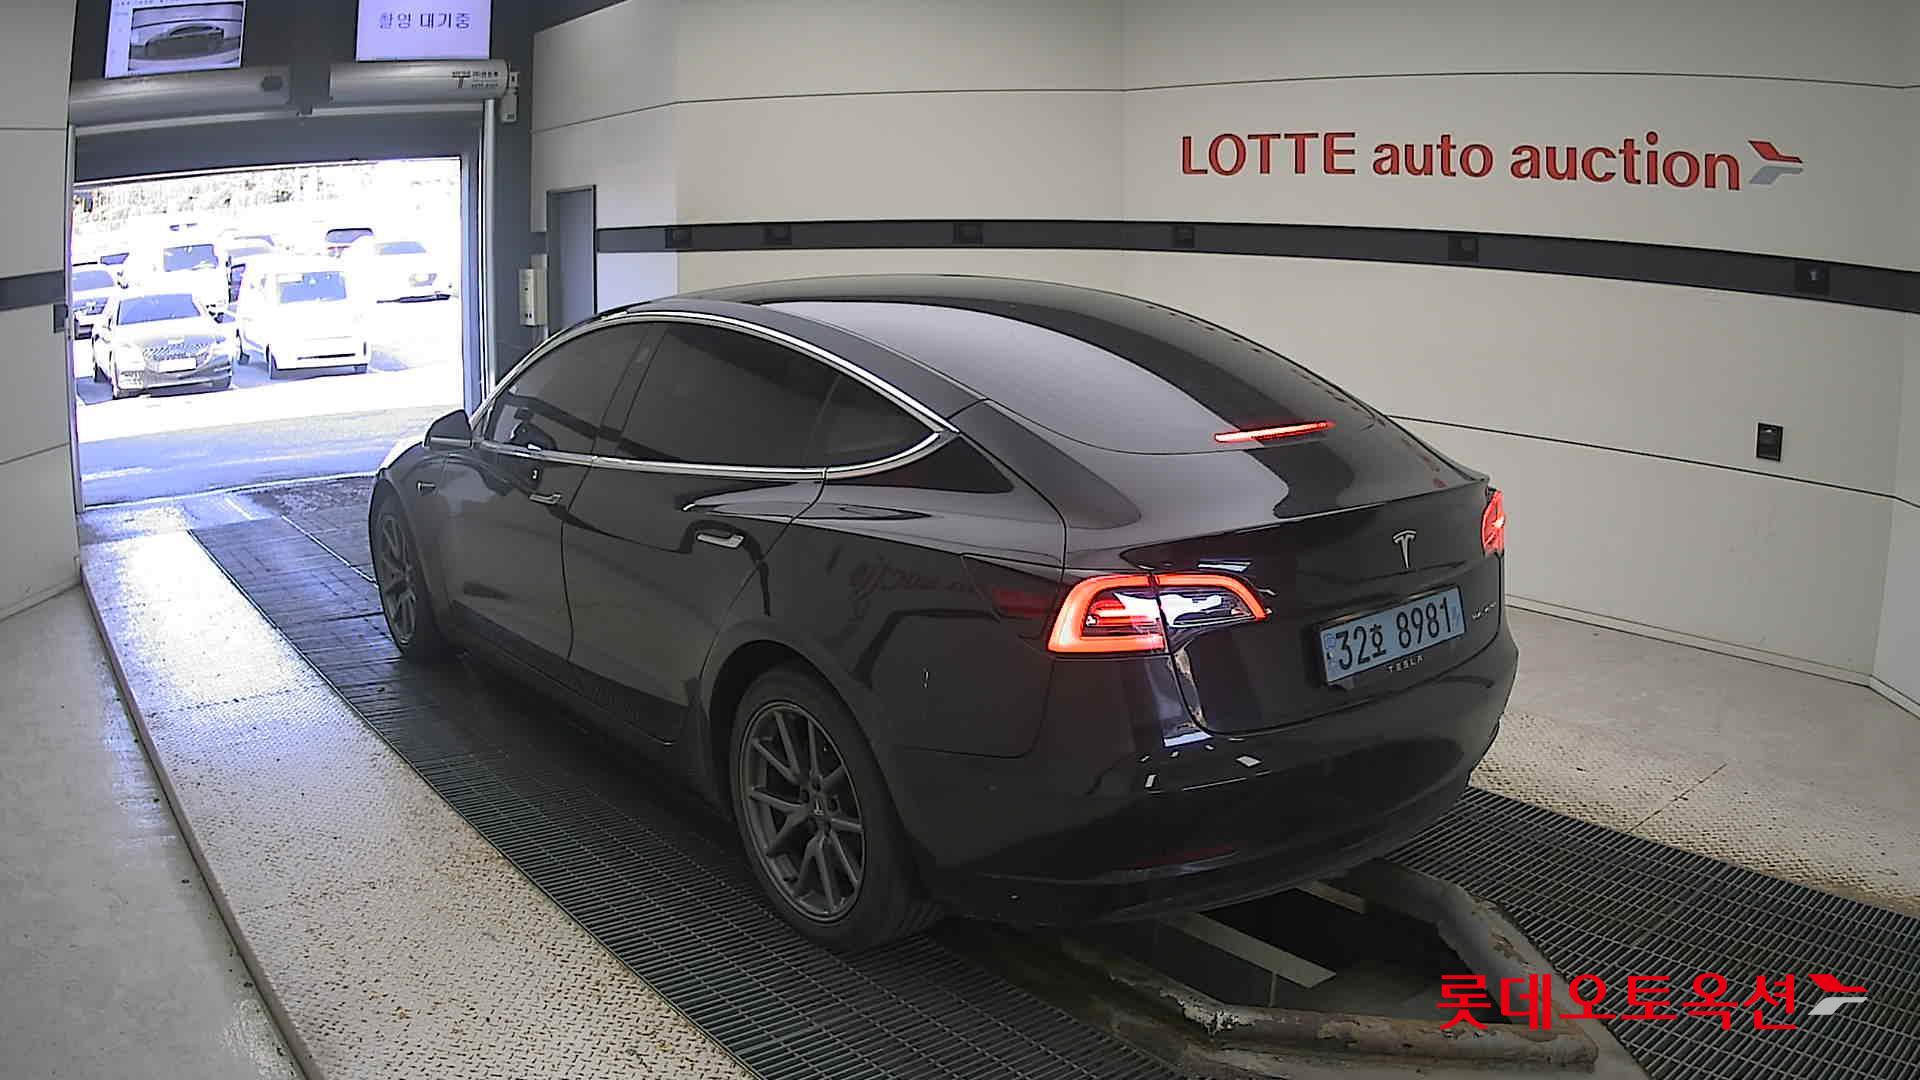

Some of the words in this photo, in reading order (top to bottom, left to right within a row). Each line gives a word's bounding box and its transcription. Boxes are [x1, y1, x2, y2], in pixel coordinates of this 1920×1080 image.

[419, 12, 471, 30] 대기중
[1182, 132, 1356, 175] LOTTE
[1373, 134, 1494, 178] auto
[1509, 131, 1741, 190] auction
[1335, 623, 1387, 670] 32호
[1395, 597, 1452, 649] 8981
[1387, 655, 1425, 673] TESLA
